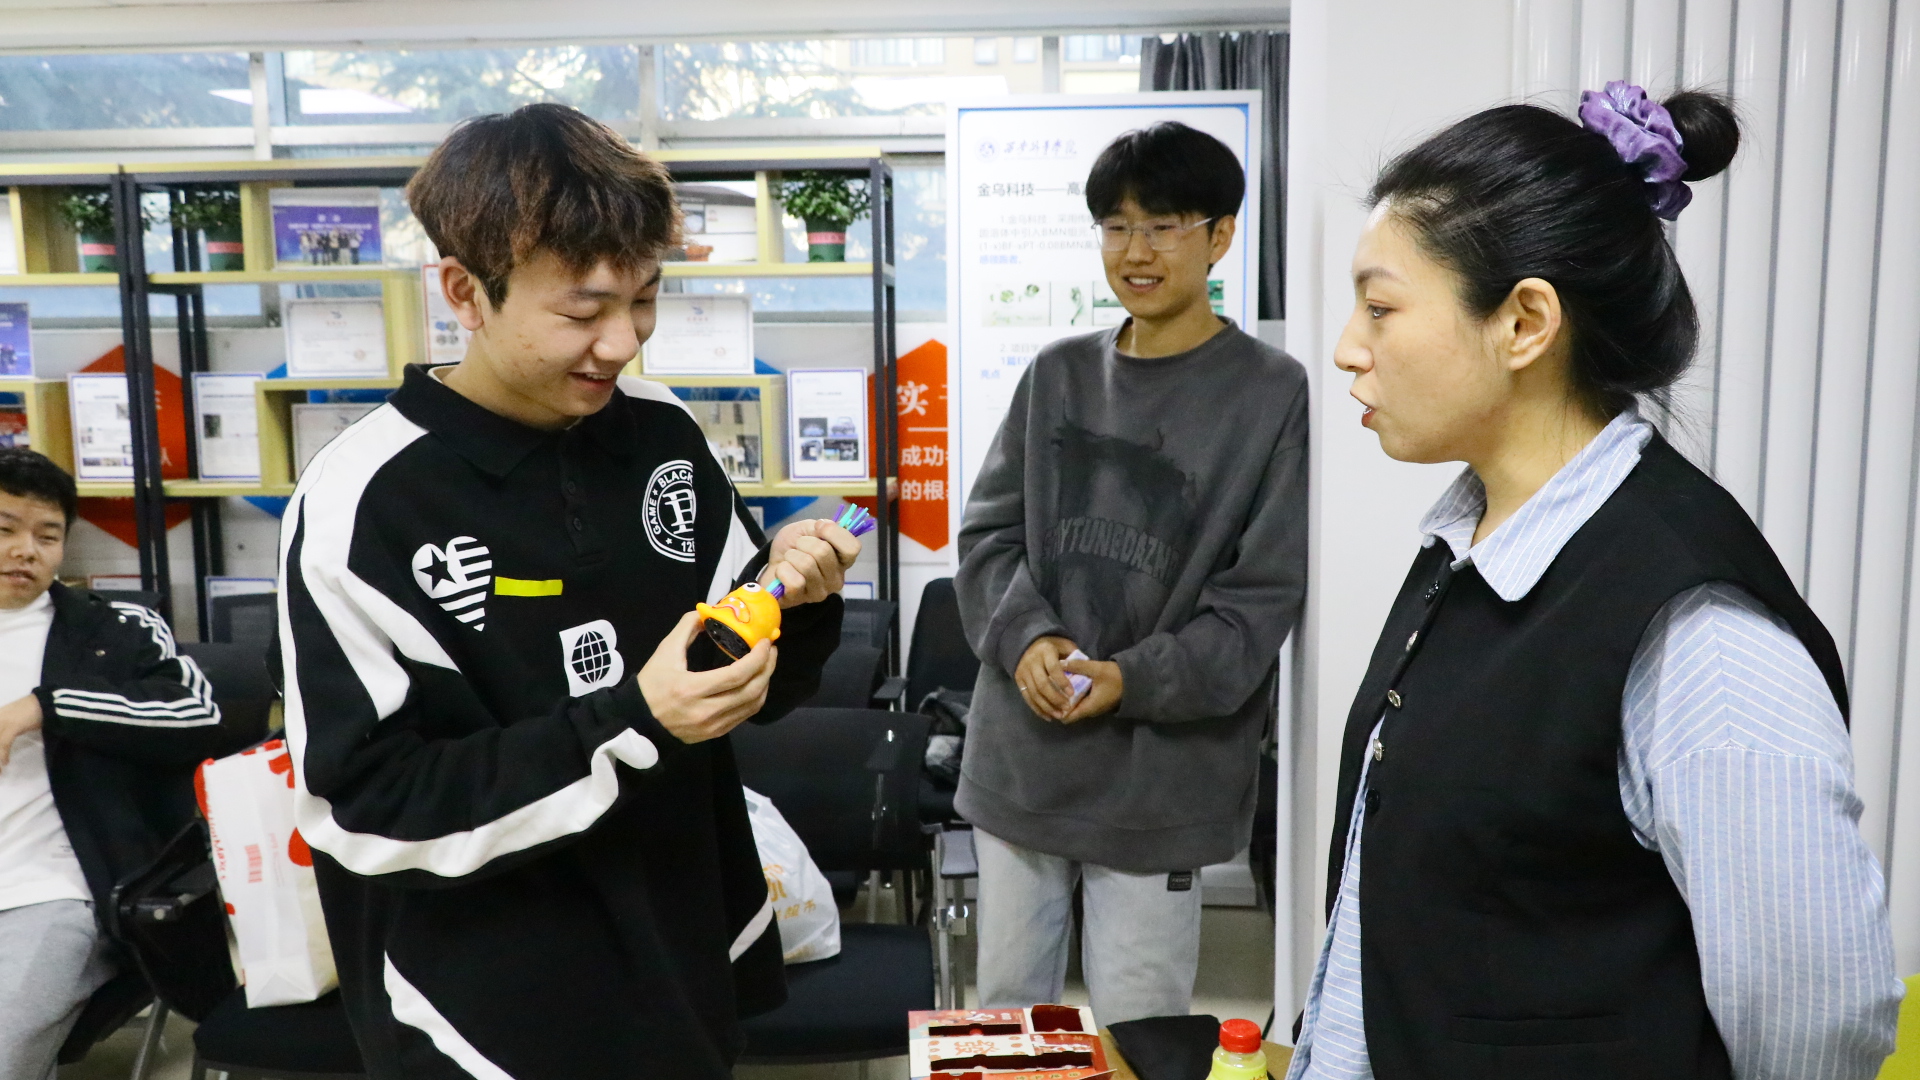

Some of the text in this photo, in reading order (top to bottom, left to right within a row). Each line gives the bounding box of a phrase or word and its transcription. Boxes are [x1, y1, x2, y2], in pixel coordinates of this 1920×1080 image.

[901, 444, 948, 467] 成功
[901, 479, 948, 501] 的根
[648, 498, 662, 535] GAME
